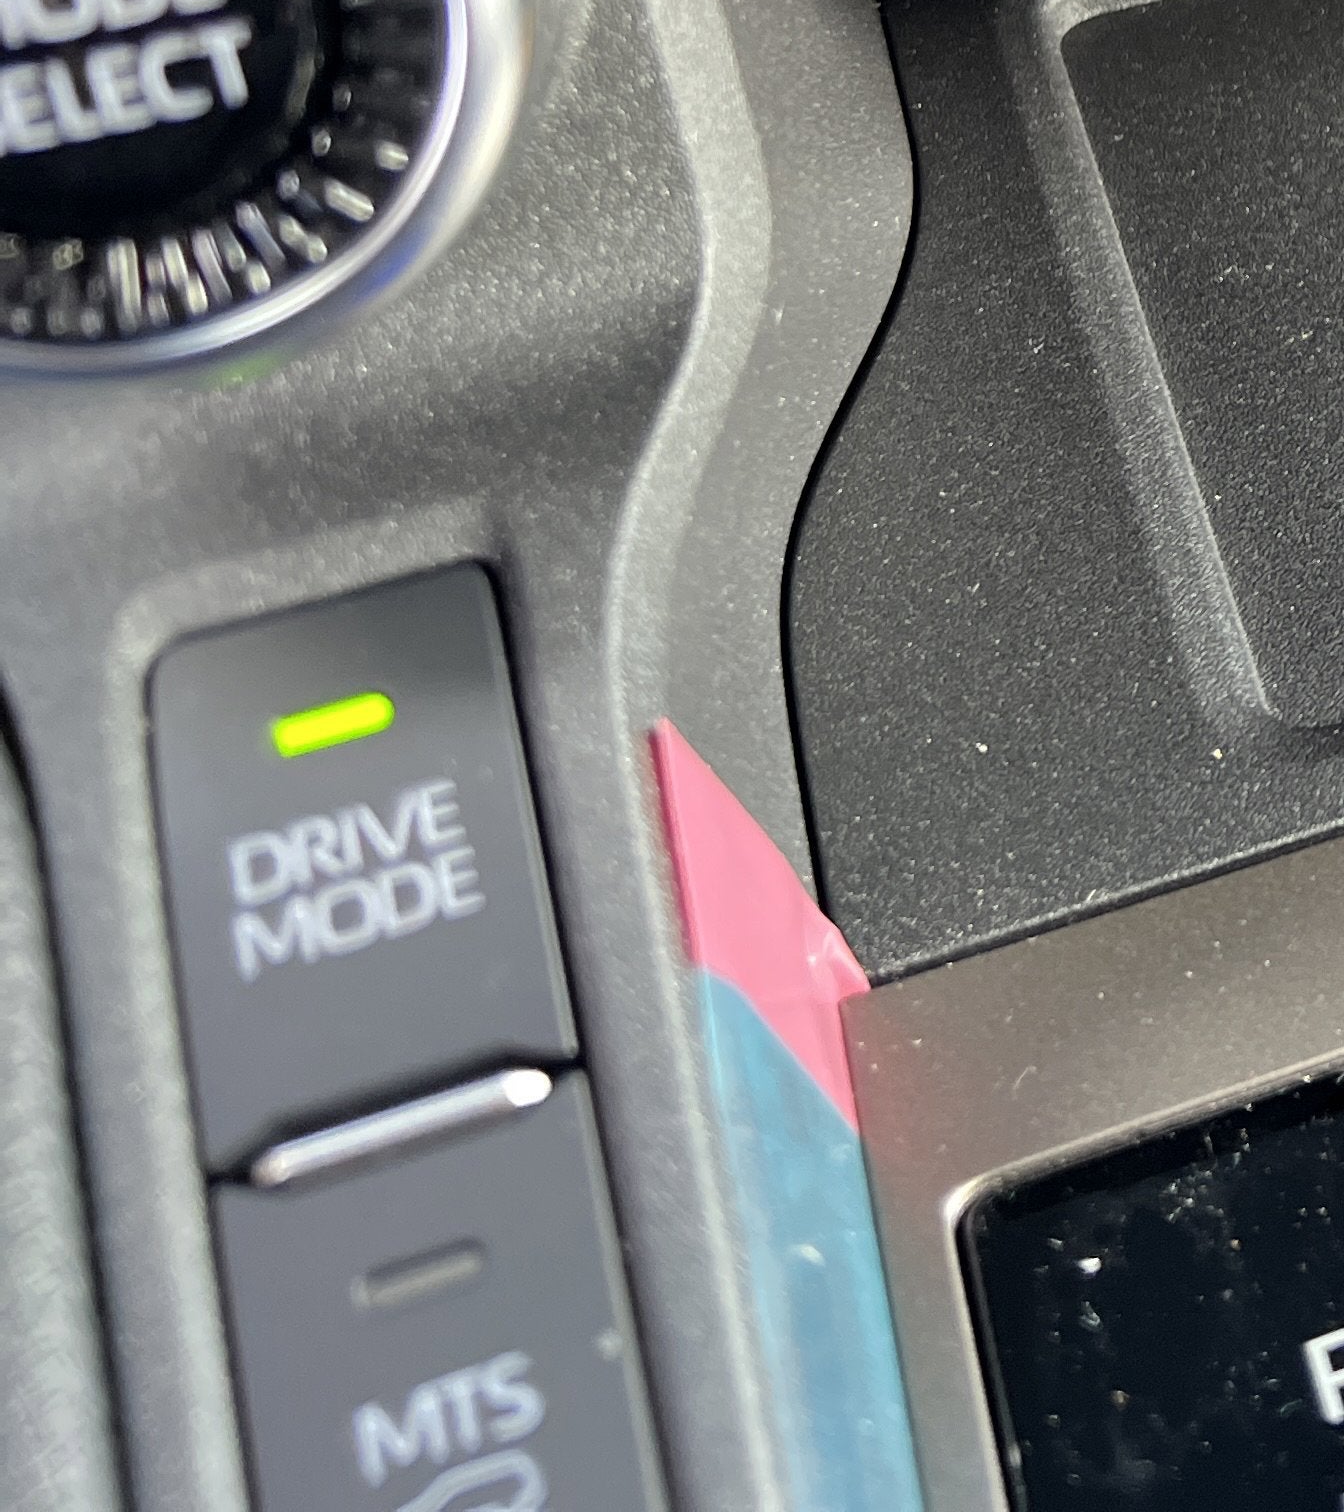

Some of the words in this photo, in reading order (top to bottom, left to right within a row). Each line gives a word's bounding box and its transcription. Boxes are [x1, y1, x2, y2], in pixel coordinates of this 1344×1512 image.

[0, 17, 252, 158] ELECT
[228, 776, 468, 906] DRIVE
[232, 846, 487, 985] MODE
[353, 1351, 546, 1489] MTS
